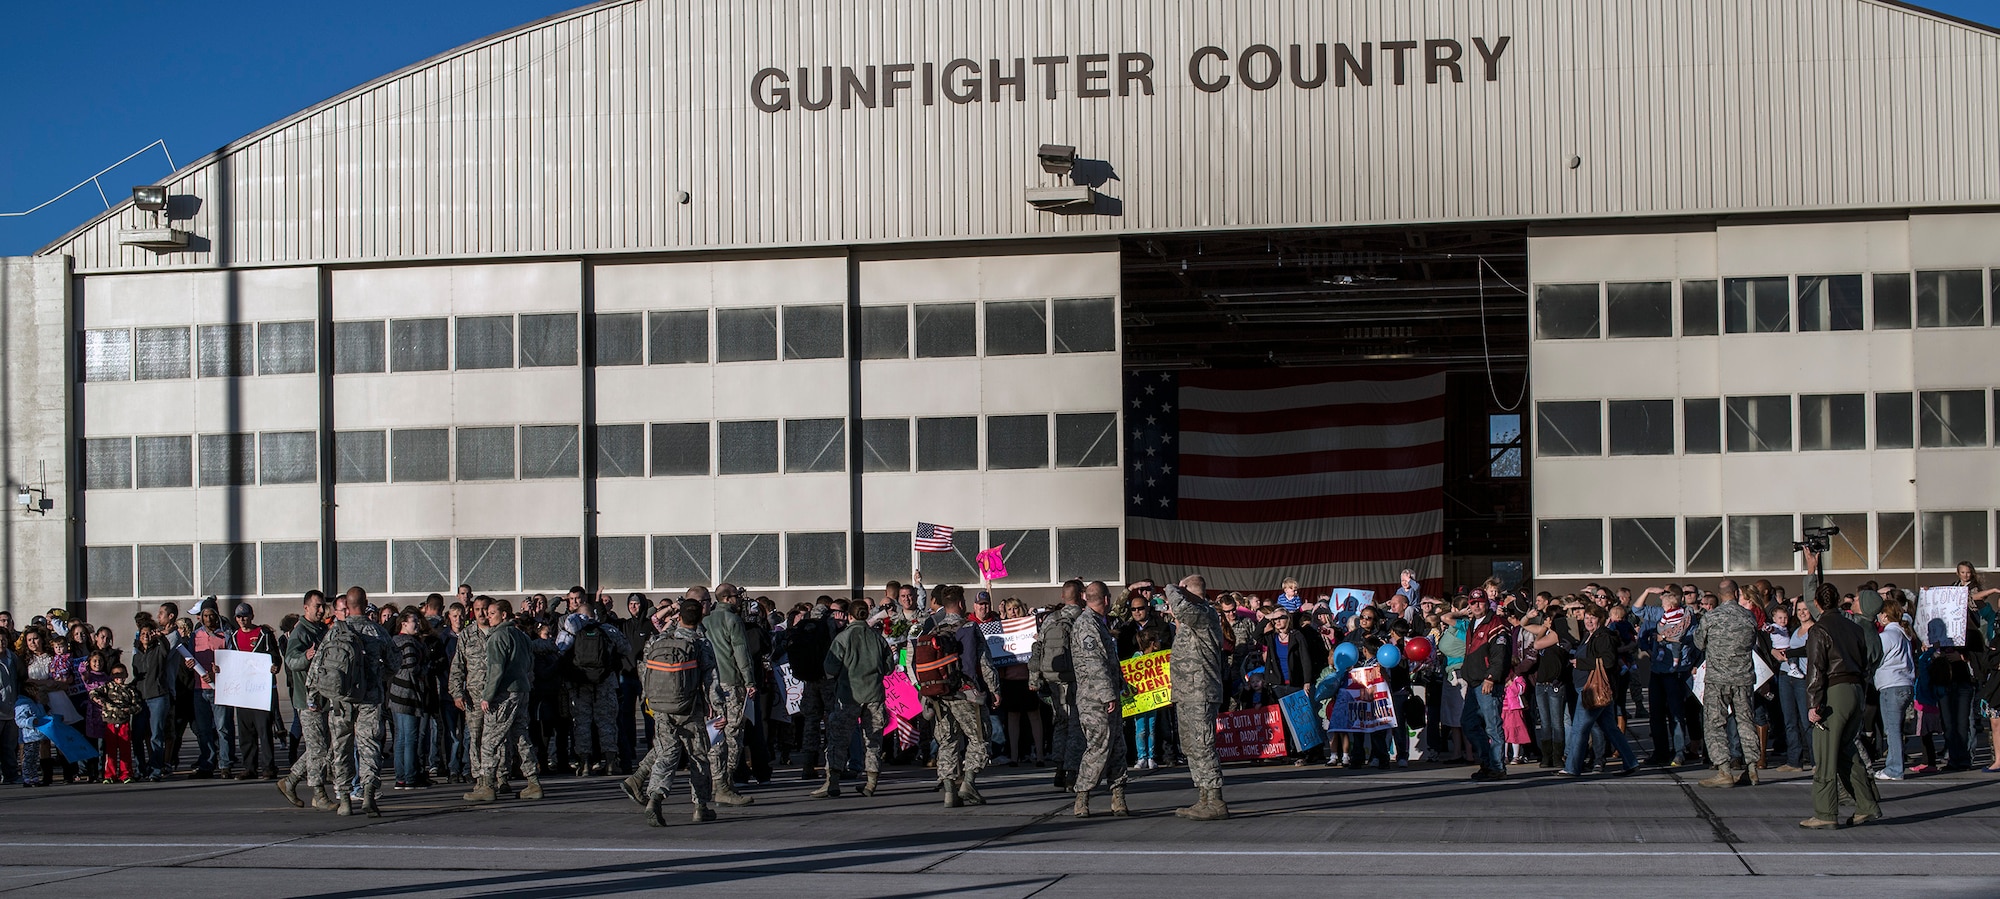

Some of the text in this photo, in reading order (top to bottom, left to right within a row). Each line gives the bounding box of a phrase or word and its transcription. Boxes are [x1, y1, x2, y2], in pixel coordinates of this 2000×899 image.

[751, 36, 1511, 113] GUNFIGHTER COUNTRY
[1919, 589, 1967, 608] ELCOME
[1121, 653, 1171, 675] ELCOME
[1125, 665, 1164, 684] HOME
[1233, 715, 1252, 728] OUTTA
[1253, 713, 1262, 726] MY
[1224, 728, 1274, 744] MY DADDY IS
[1242, 743, 1260, 756] HOME
